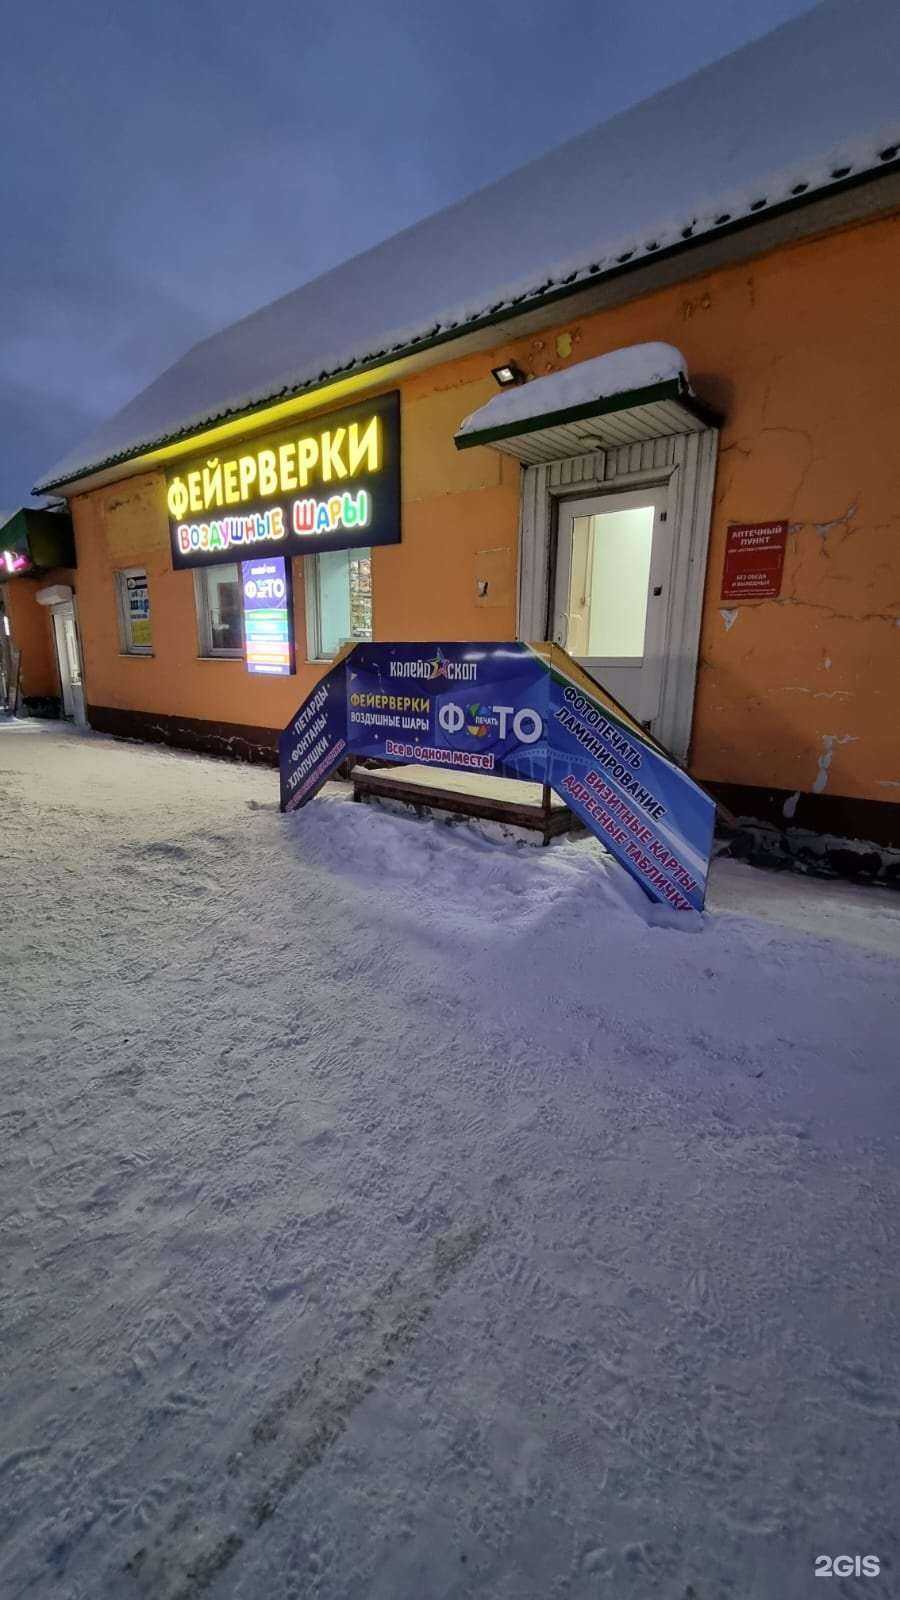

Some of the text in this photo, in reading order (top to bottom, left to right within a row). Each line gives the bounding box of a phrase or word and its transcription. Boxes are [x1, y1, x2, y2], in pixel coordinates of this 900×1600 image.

[167, 416, 380, 520] ФЕЙЕРВЕРКИ
[177, 489, 369, 553] ВОЗДУШНЫЕ ШАРЫ
[732, 526, 782, 538] АПТЕЧНЫЙ
[740, 537, 770, 545] ПУНКТ
[294, 685, 329, 735] ПЕТАРДЫ
[350, 692, 430, 713] ФЕЙЕРВЕРКИ
[350, 711, 430, 732] ВОЗДУШНЫЕ ШАРЫ
[475, 715, 499, 726] ПЕЧАТЬ
[291, 713, 327, 761] ФОНТАНЫ
[564, 687, 642, 770] ФОТОПЕЧАТЬ
[287, 735, 330, 790] ХЛОПУШКИ
[385, 739, 405, 756] Все
[414, 747, 452, 764] одном
[452, 753, 494, 770] месте!
[555, 708, 667, 823] ЛАМИНИРОВАНИЕ
[561, 774, 628, 844] АДРЕСНЫЕ
[584, 771, 697, 892] ВИЗИТНЫЕ КАРТЫ
